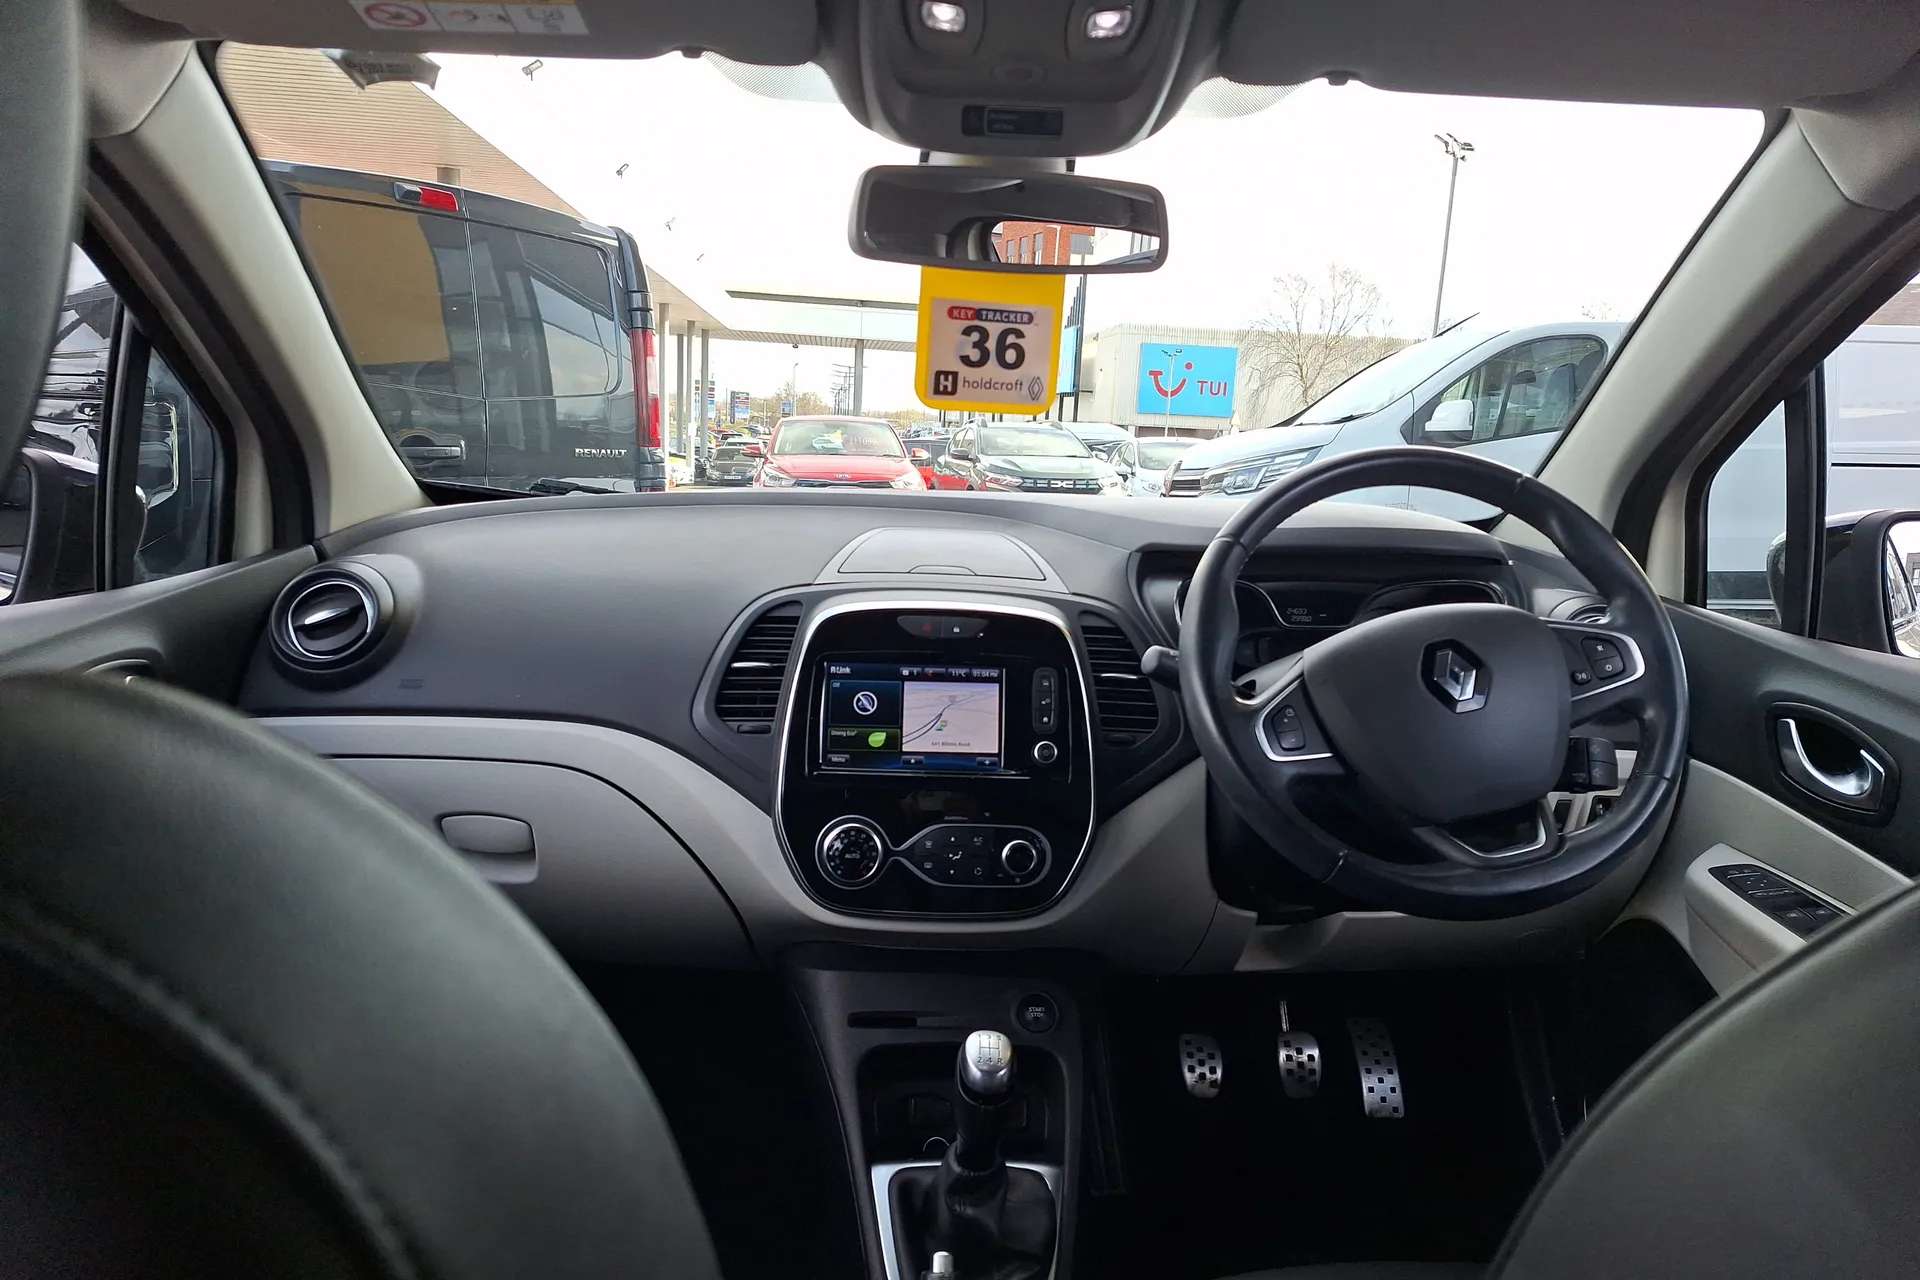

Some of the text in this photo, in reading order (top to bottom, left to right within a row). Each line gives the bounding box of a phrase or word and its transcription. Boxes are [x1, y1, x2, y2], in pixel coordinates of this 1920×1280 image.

[952, 309, 1029, 323] KEY TRACKER
[959, 325, 1026, 370] 36
[962, 376, 1023, 391] holdcroft
[1197, 380, 1228, 396] TUI
[575, 448, 627, 458] RENAULT
